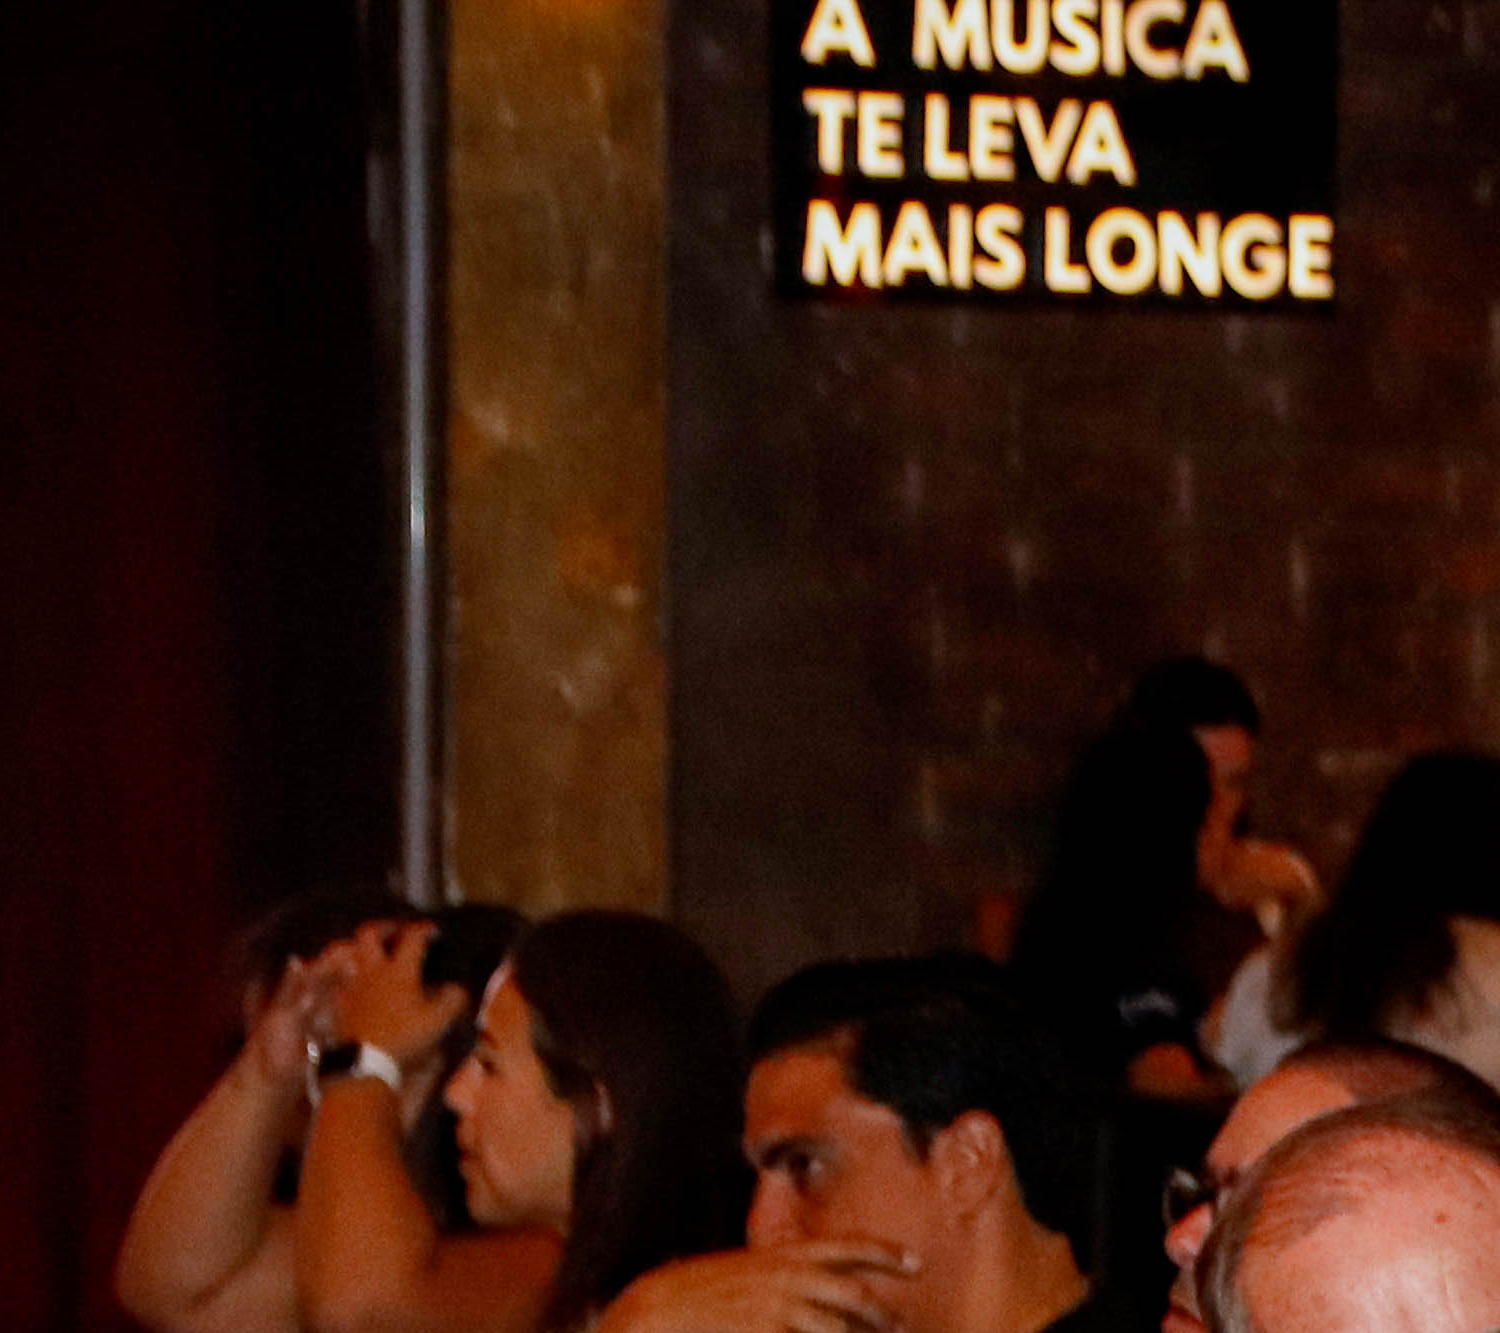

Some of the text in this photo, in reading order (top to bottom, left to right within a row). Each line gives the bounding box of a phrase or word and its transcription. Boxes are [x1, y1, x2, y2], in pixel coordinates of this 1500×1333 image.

[801, 0, 876, 67] A
[802, 87, 1137, 187] TE LEVA
[802, 198, 1335, 300] MAIS LONGE
